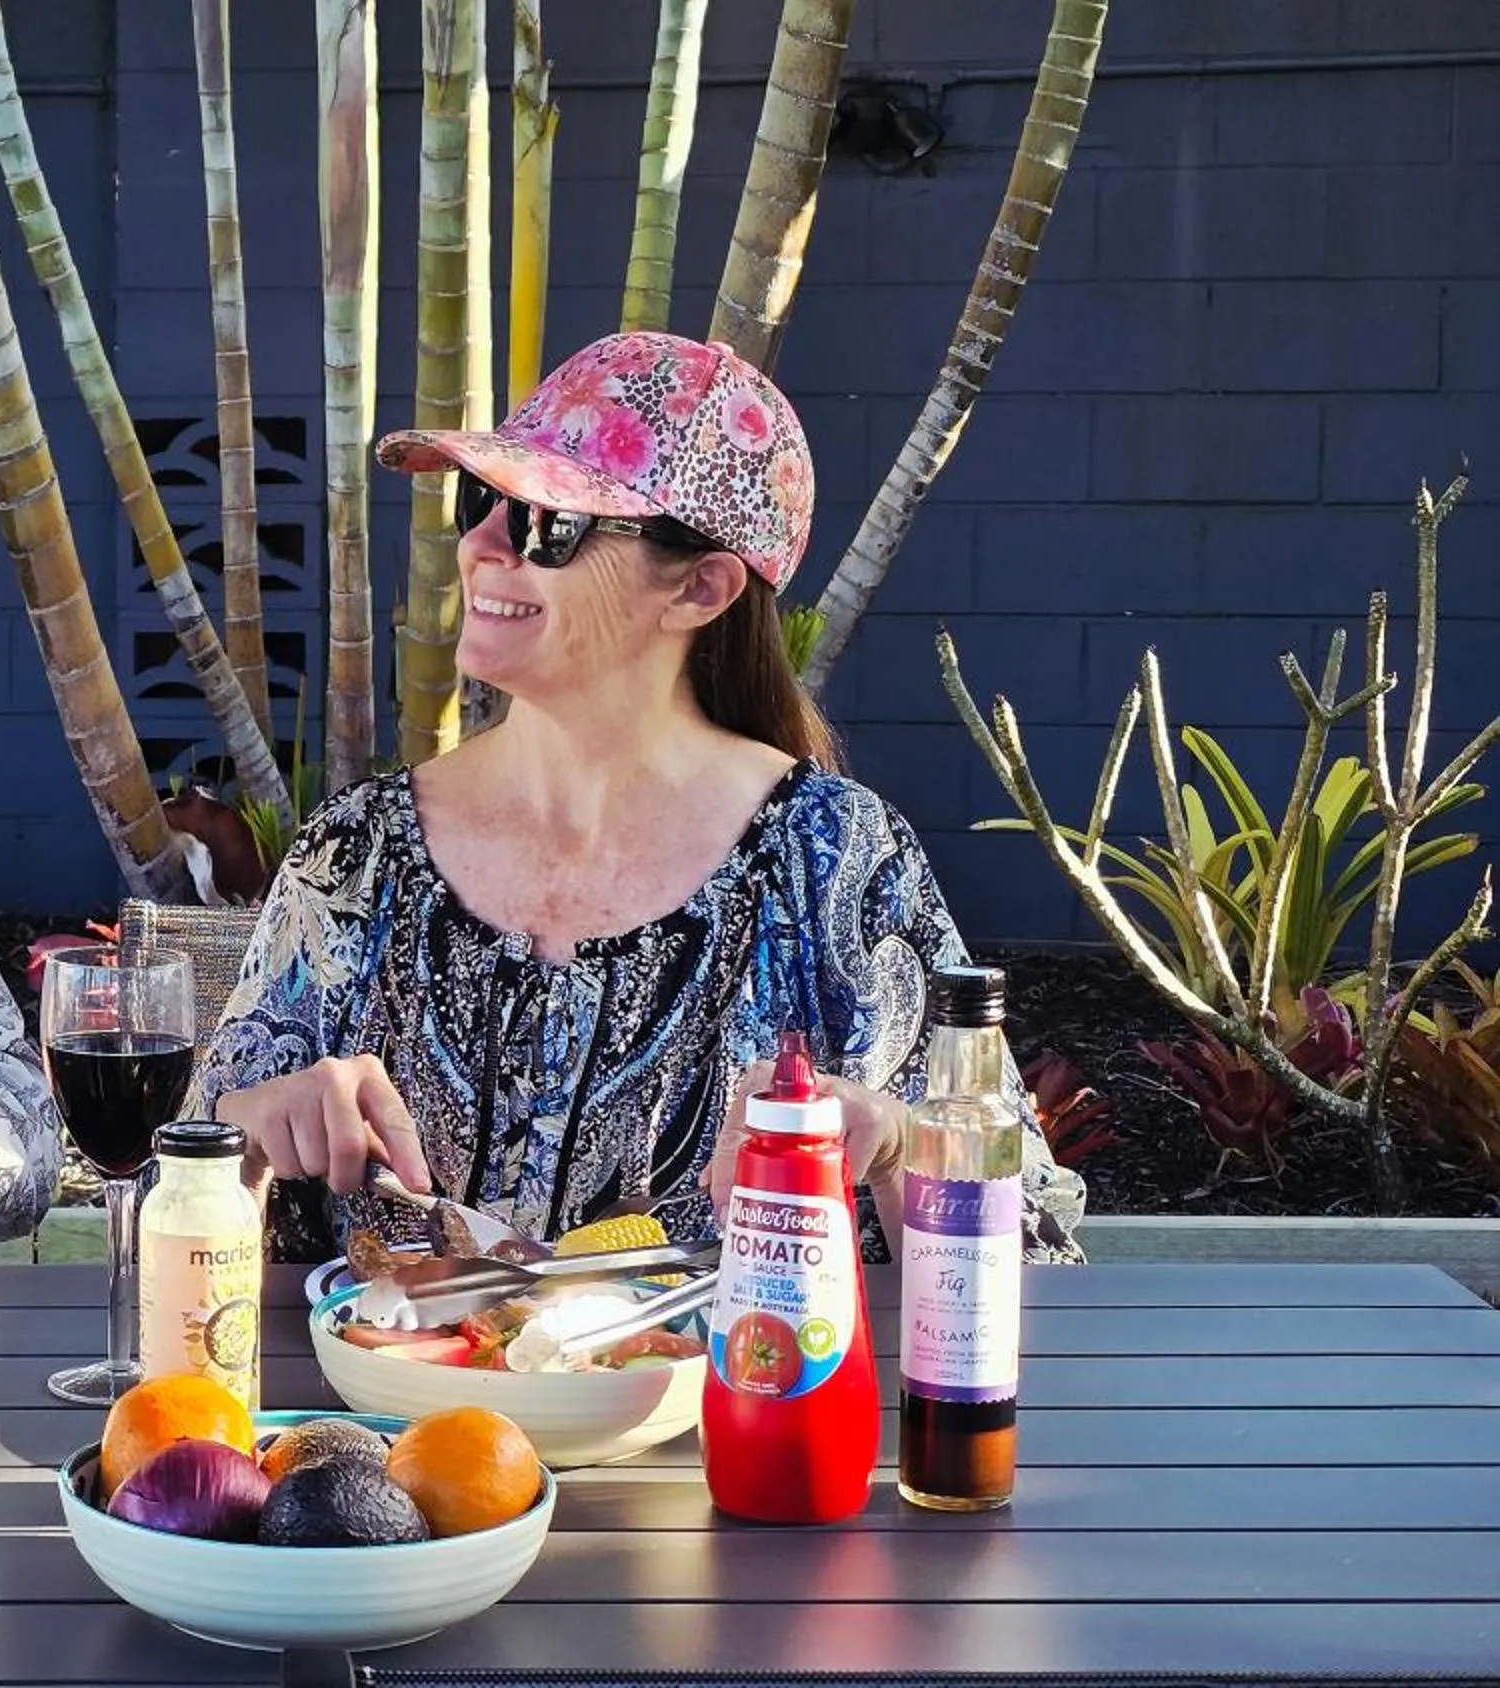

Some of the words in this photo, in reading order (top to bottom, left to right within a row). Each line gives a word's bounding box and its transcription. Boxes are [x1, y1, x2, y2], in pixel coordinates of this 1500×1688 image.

[189, 1240, 259, 1266] mario
[731, 1232, 823, 1266] TOMATO
[754, 1262, 787, 1277] SAUCE
[936, 1268, 967, 1298] Fig
[766, 1288, 807, 1305] SUGAR
[914, 1319, 989, 1343] BALSAMIC
